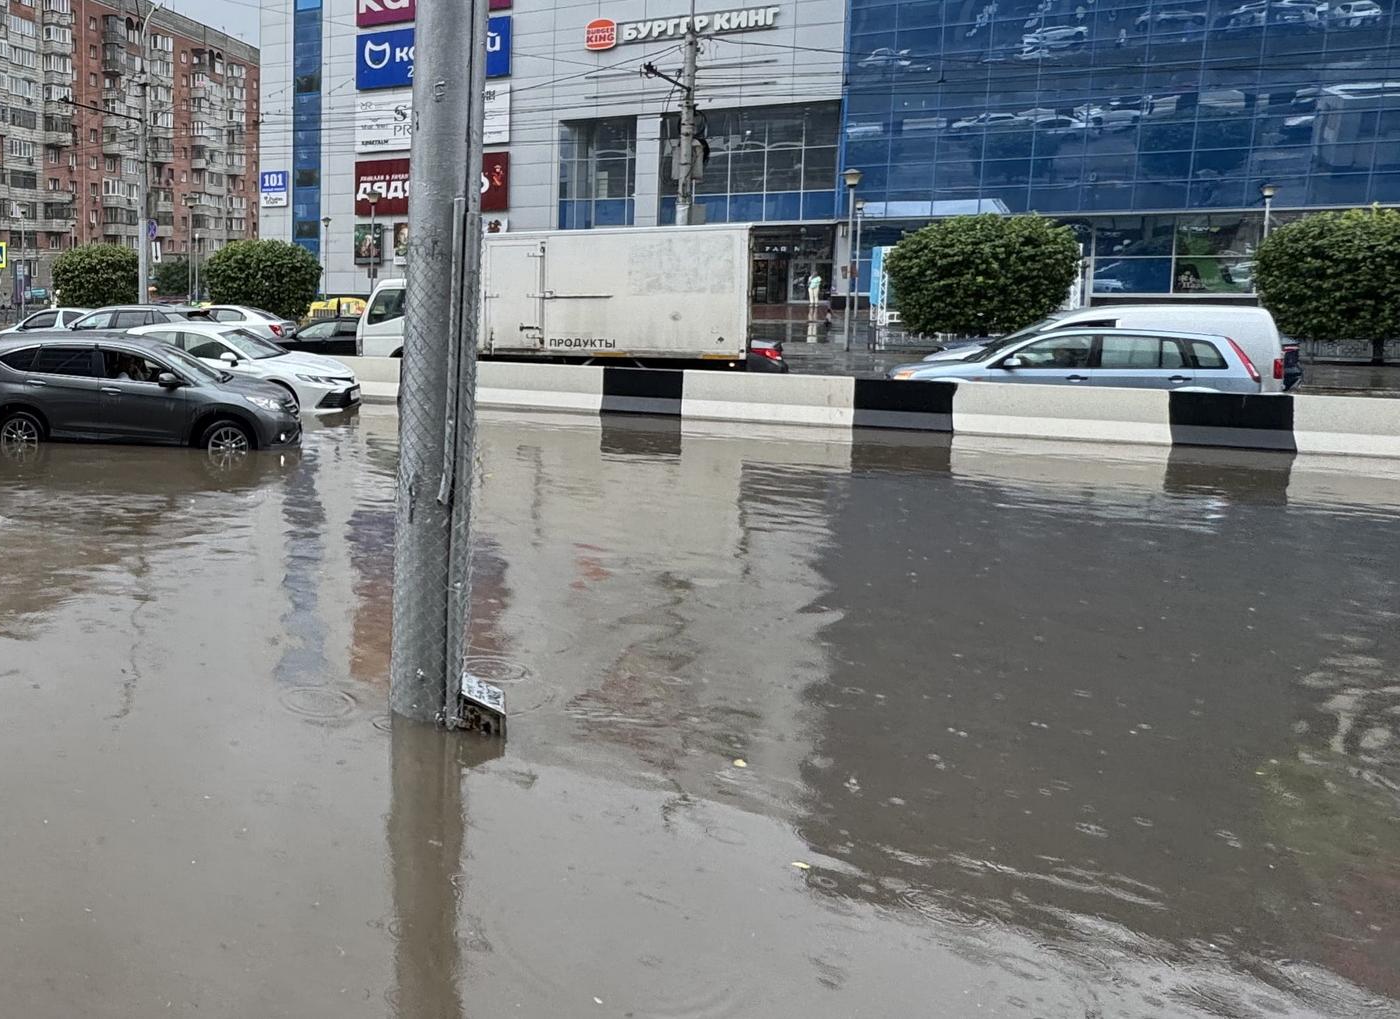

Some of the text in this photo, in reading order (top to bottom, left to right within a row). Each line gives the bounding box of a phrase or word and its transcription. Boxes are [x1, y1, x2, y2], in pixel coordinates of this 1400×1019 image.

[713, 7, 780, 31] КИНГ
[587, 27, 615, 35] BURGER
[586, 33, 615, 43] KING
[263, 173, 284, 187] 101
[549, 338, 616, 349] ПРОДУКТЫ
